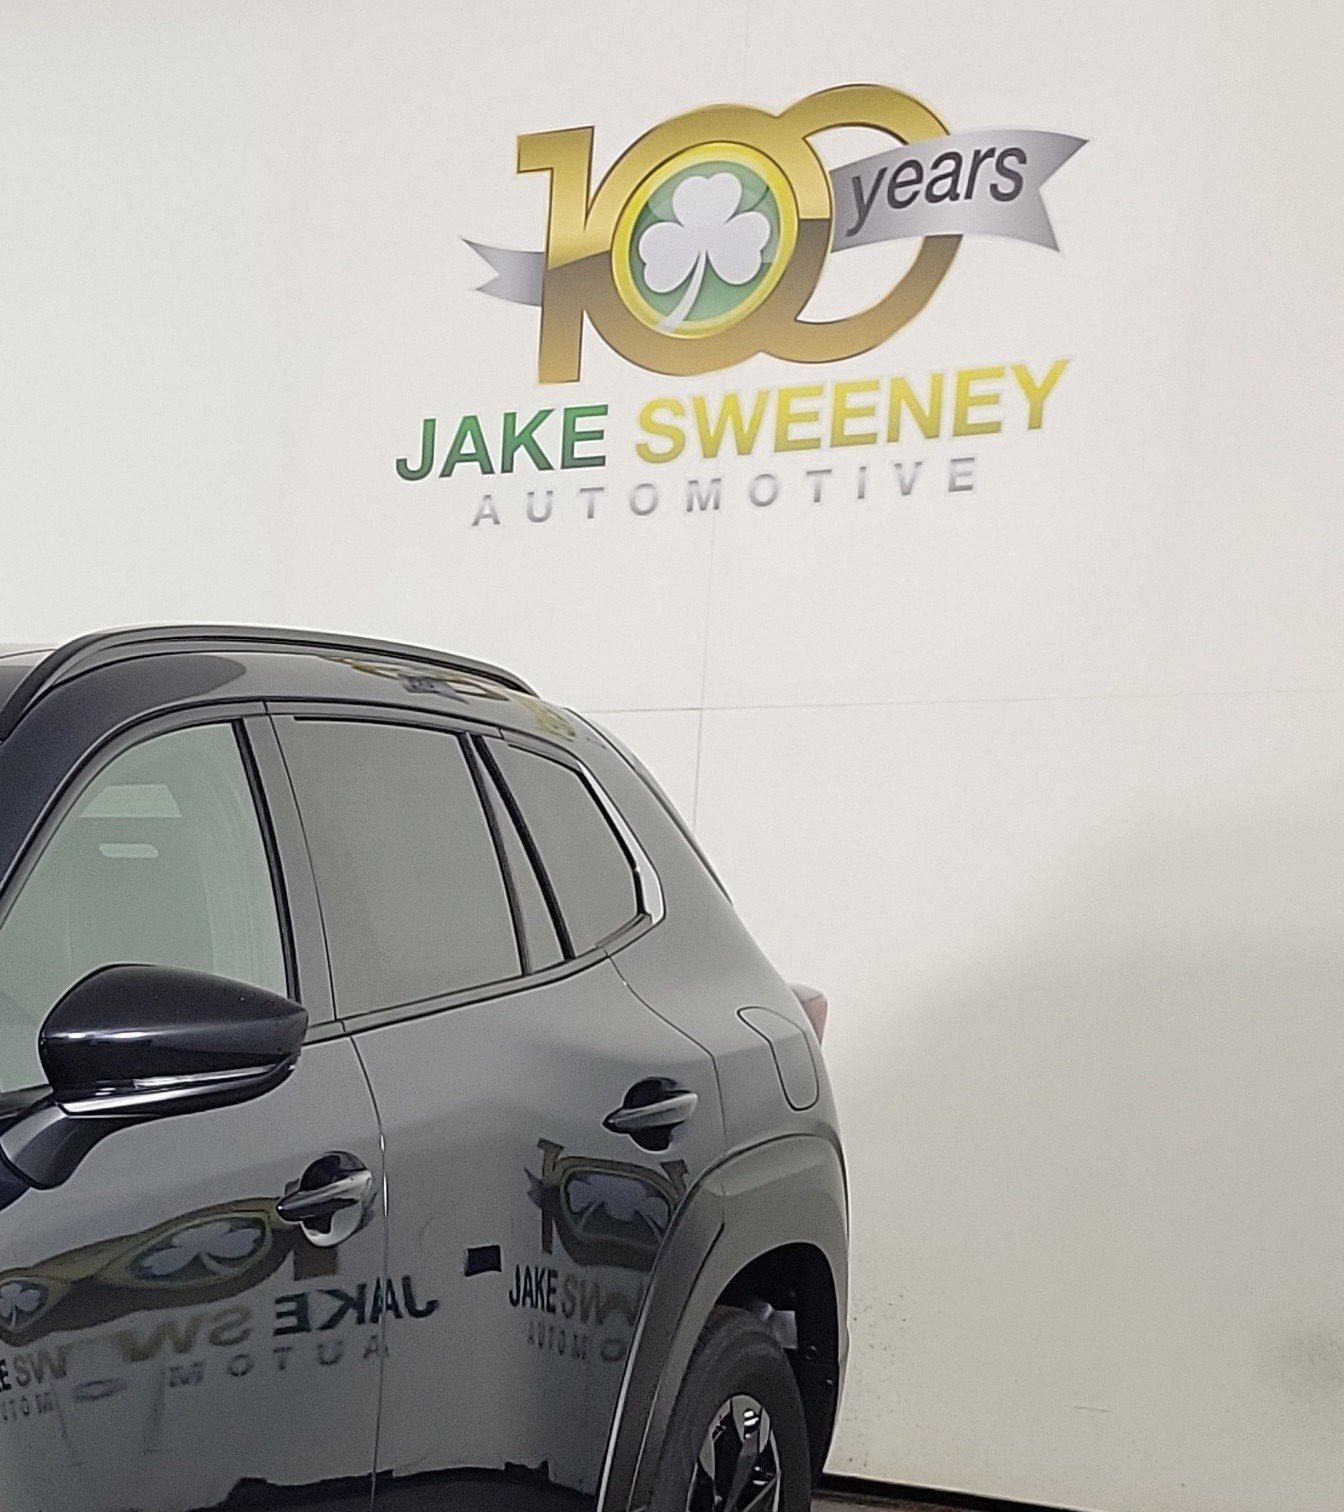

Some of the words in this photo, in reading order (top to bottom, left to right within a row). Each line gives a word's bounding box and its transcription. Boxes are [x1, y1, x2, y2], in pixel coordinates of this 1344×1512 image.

[517, 83, 964, 385] 100
[846, 143, 1028, 238] years
[395, 403, 610, 482] JAKE
[635, 359, 1070, 465] SWEENEY
[472, 456, 978, 528] AUTOMOTIVE
[509, 1264, 559, 1314] JAKE
